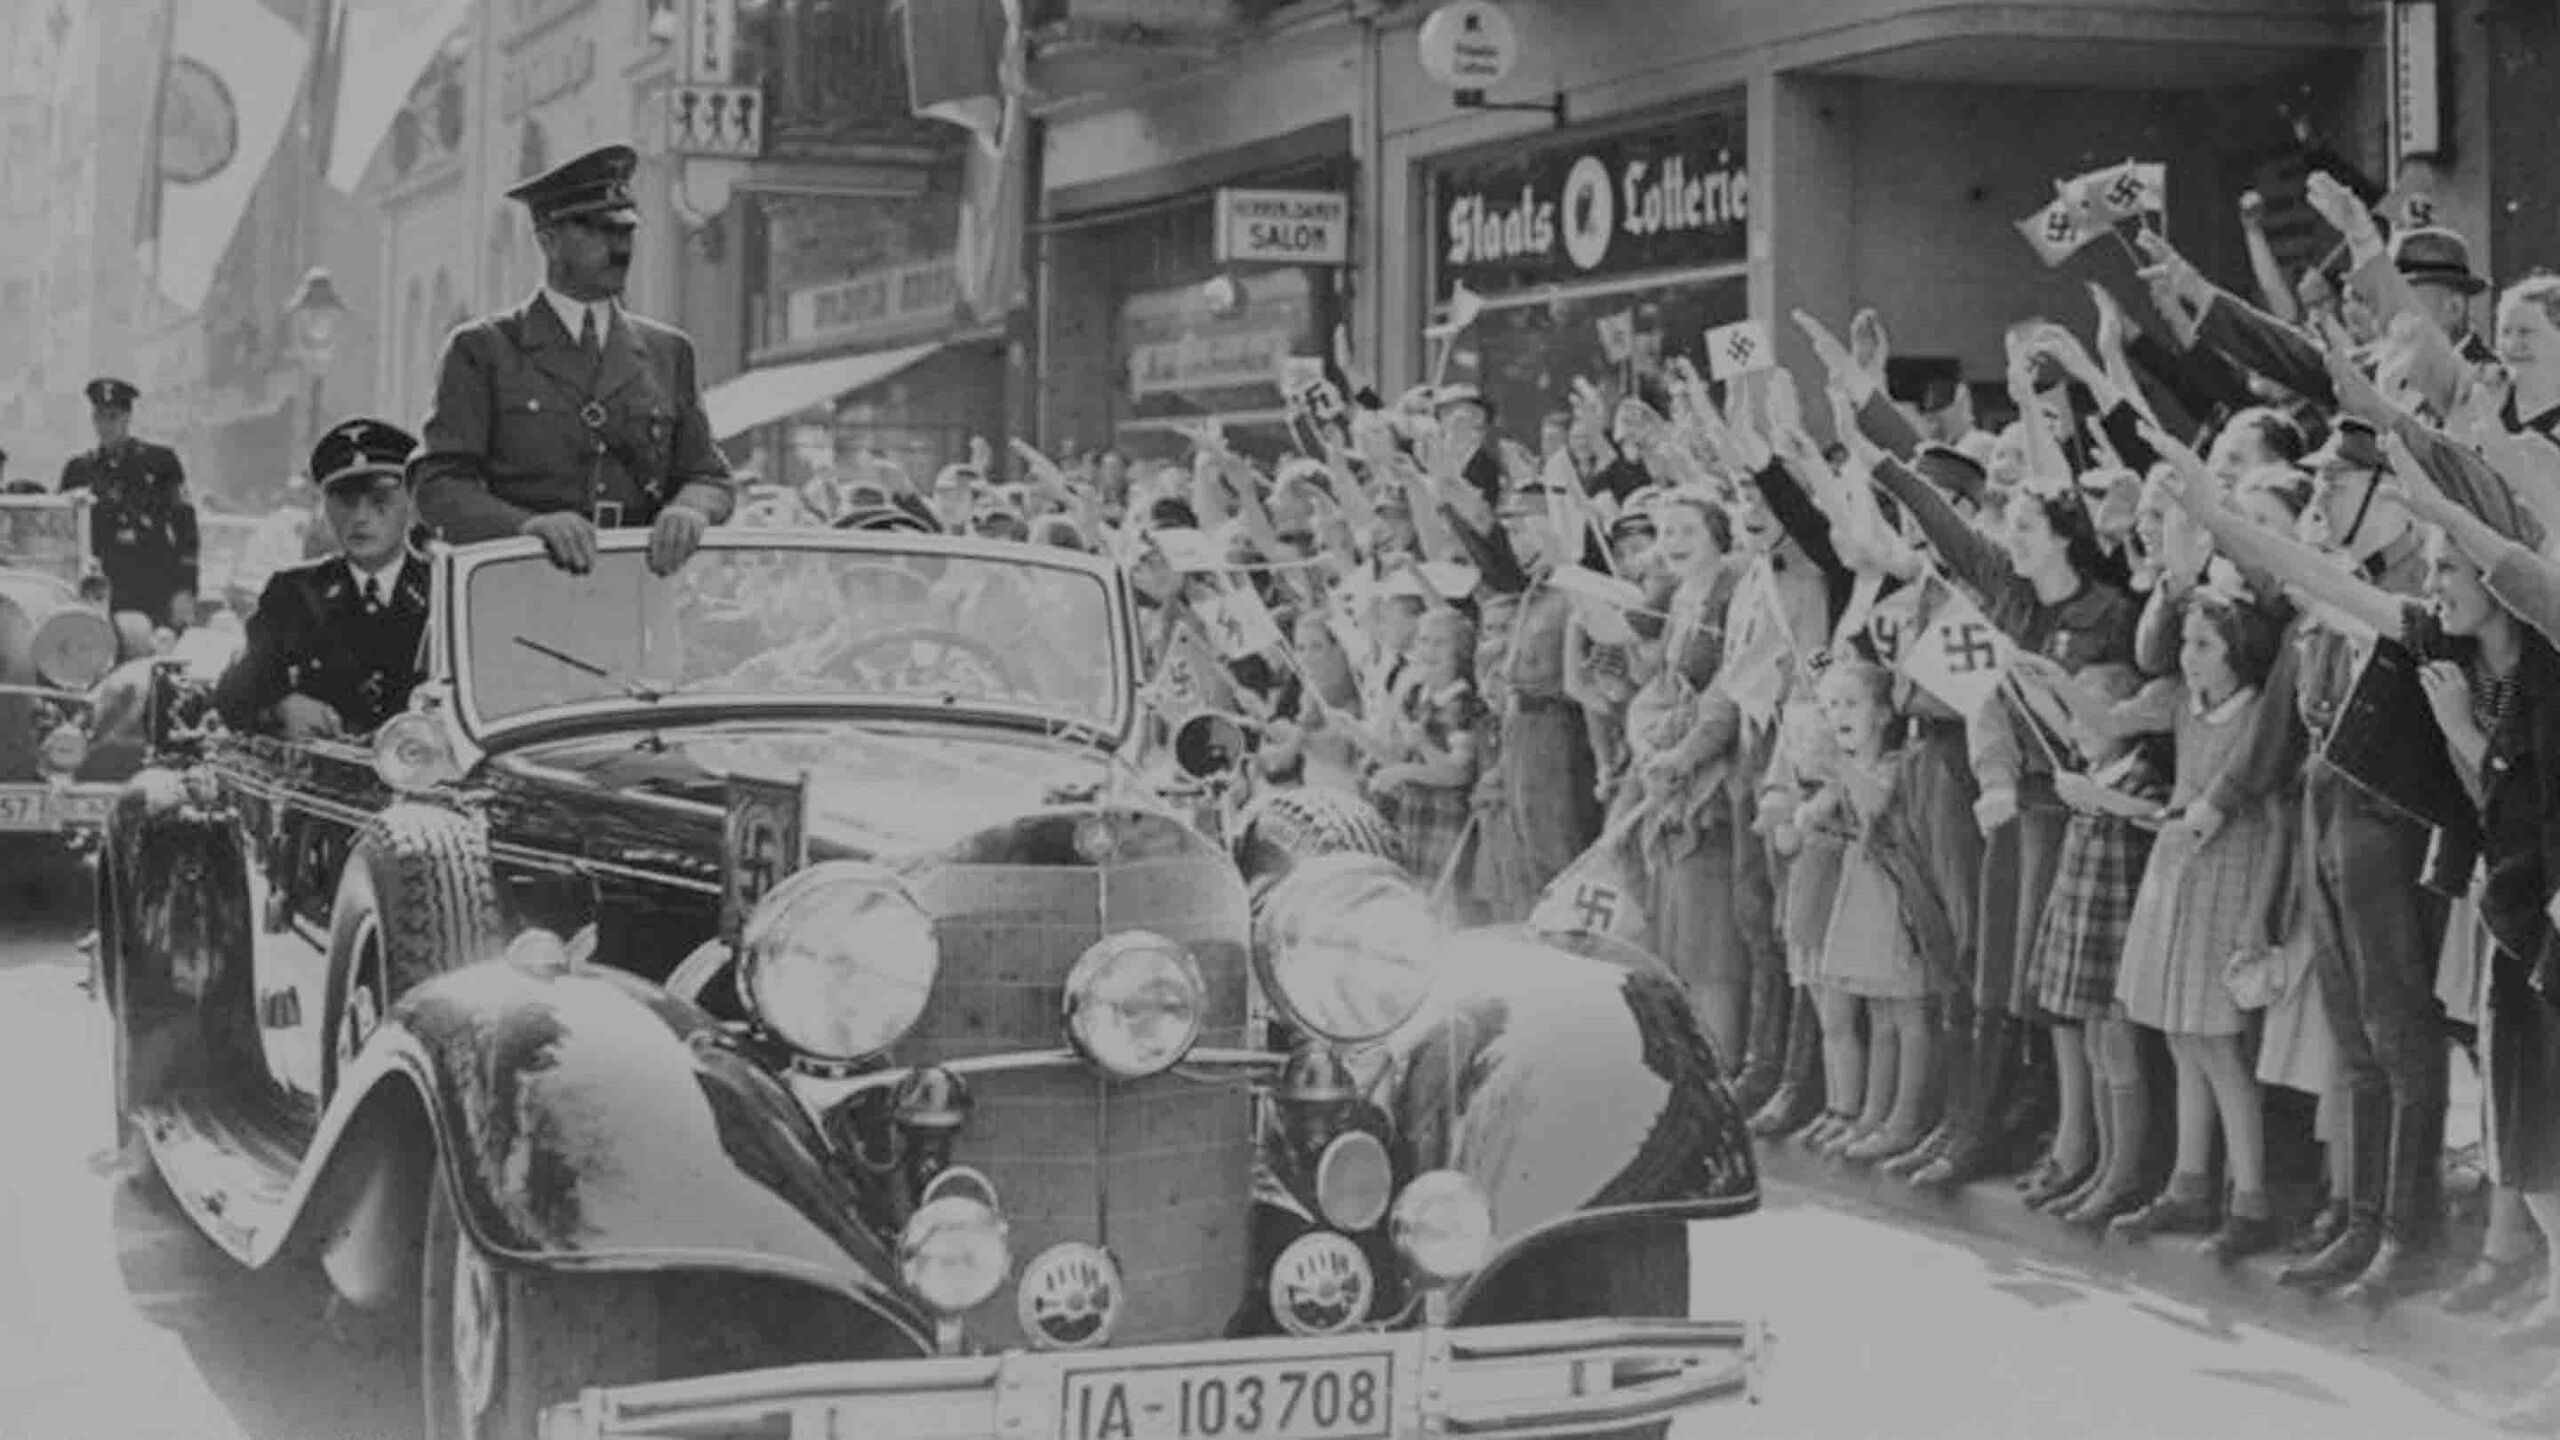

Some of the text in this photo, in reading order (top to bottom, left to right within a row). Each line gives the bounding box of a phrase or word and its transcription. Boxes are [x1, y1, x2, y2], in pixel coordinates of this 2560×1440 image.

[1249, 221, 1325, 251] SALON
[1447, 149, 1748, 264] Staats Lotterie
